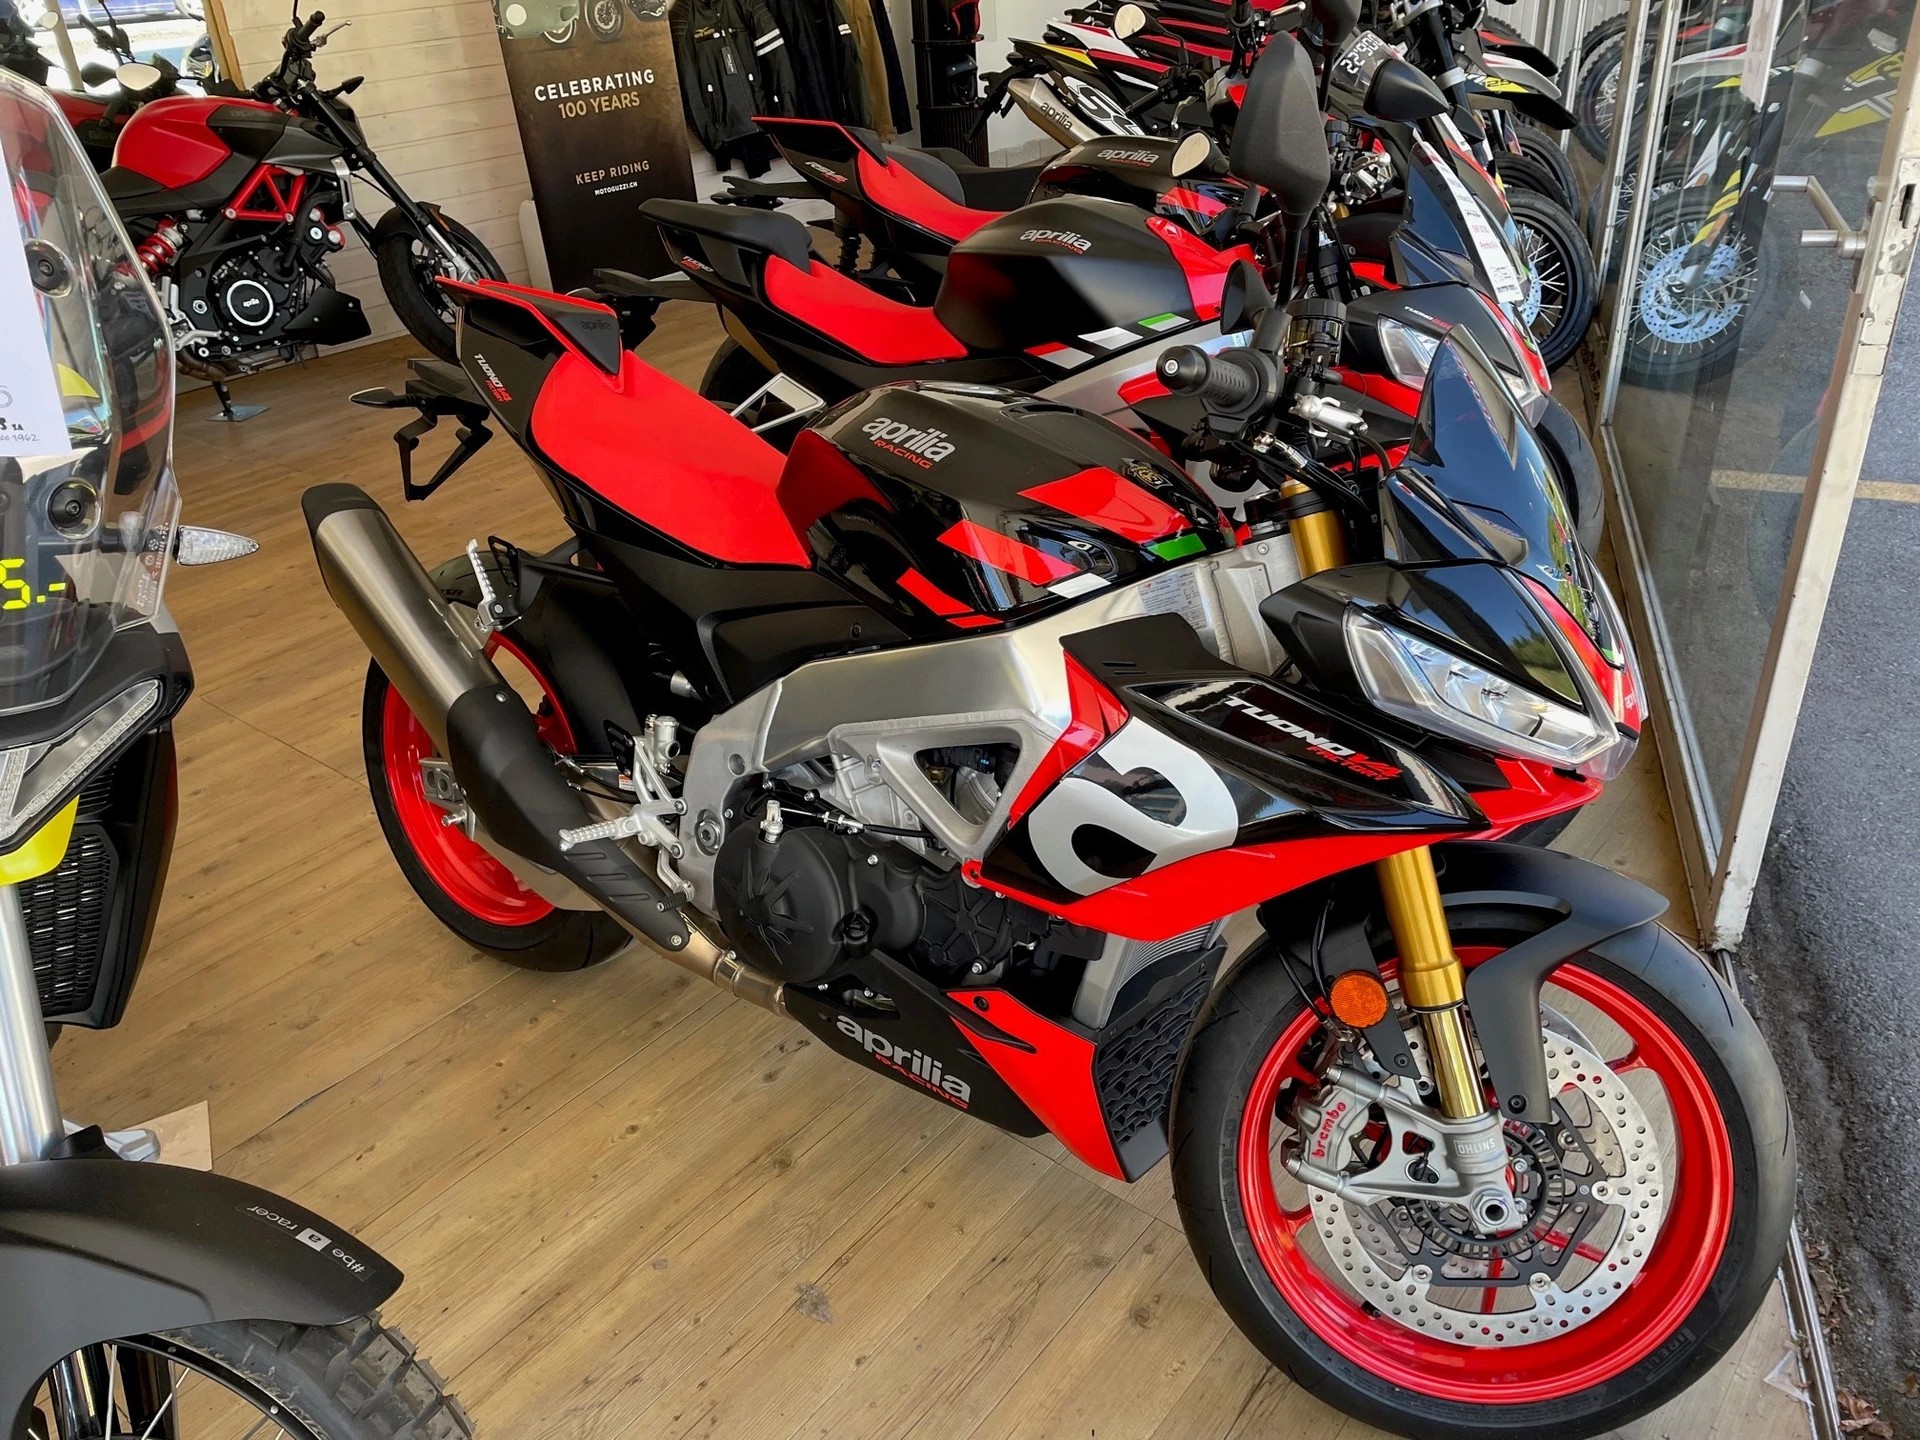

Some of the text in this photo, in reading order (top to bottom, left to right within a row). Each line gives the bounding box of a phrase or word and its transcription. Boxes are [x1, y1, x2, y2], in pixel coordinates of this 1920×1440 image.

[534, 69, 655, 101] CELEBRATING
[558, 91, 640, 119] 100 YEARS
[1040, 101, 1073, 131] aprilia
[575, 160, 650, 185] KEEP RIDING
[1097, 149, 1160, 165] aprilia
[594, 181, 638, 196] MOTOGUZZI.CH
[1020, 229, 1092, 252] aprilia
[1035, 238, 1084, 255] RACING
[473, 353, 503, 388] TUONO
[862, 417, 956, 463] aprilia
[873, 439, 933, 469] RACING
[1225, 695, 1356, 757] TUONO
[1306, 745, 1389, 781] FACTORY
[836, 1015, 972, 1103] aprilia
[875, 1053, 969, 1109] RACING
[1312, 1102, 1347, 1159] brembo
[1457, 1138, 1496, 1156] ÖHLINS
[247, 1205, 366, 1274] #be a racer
